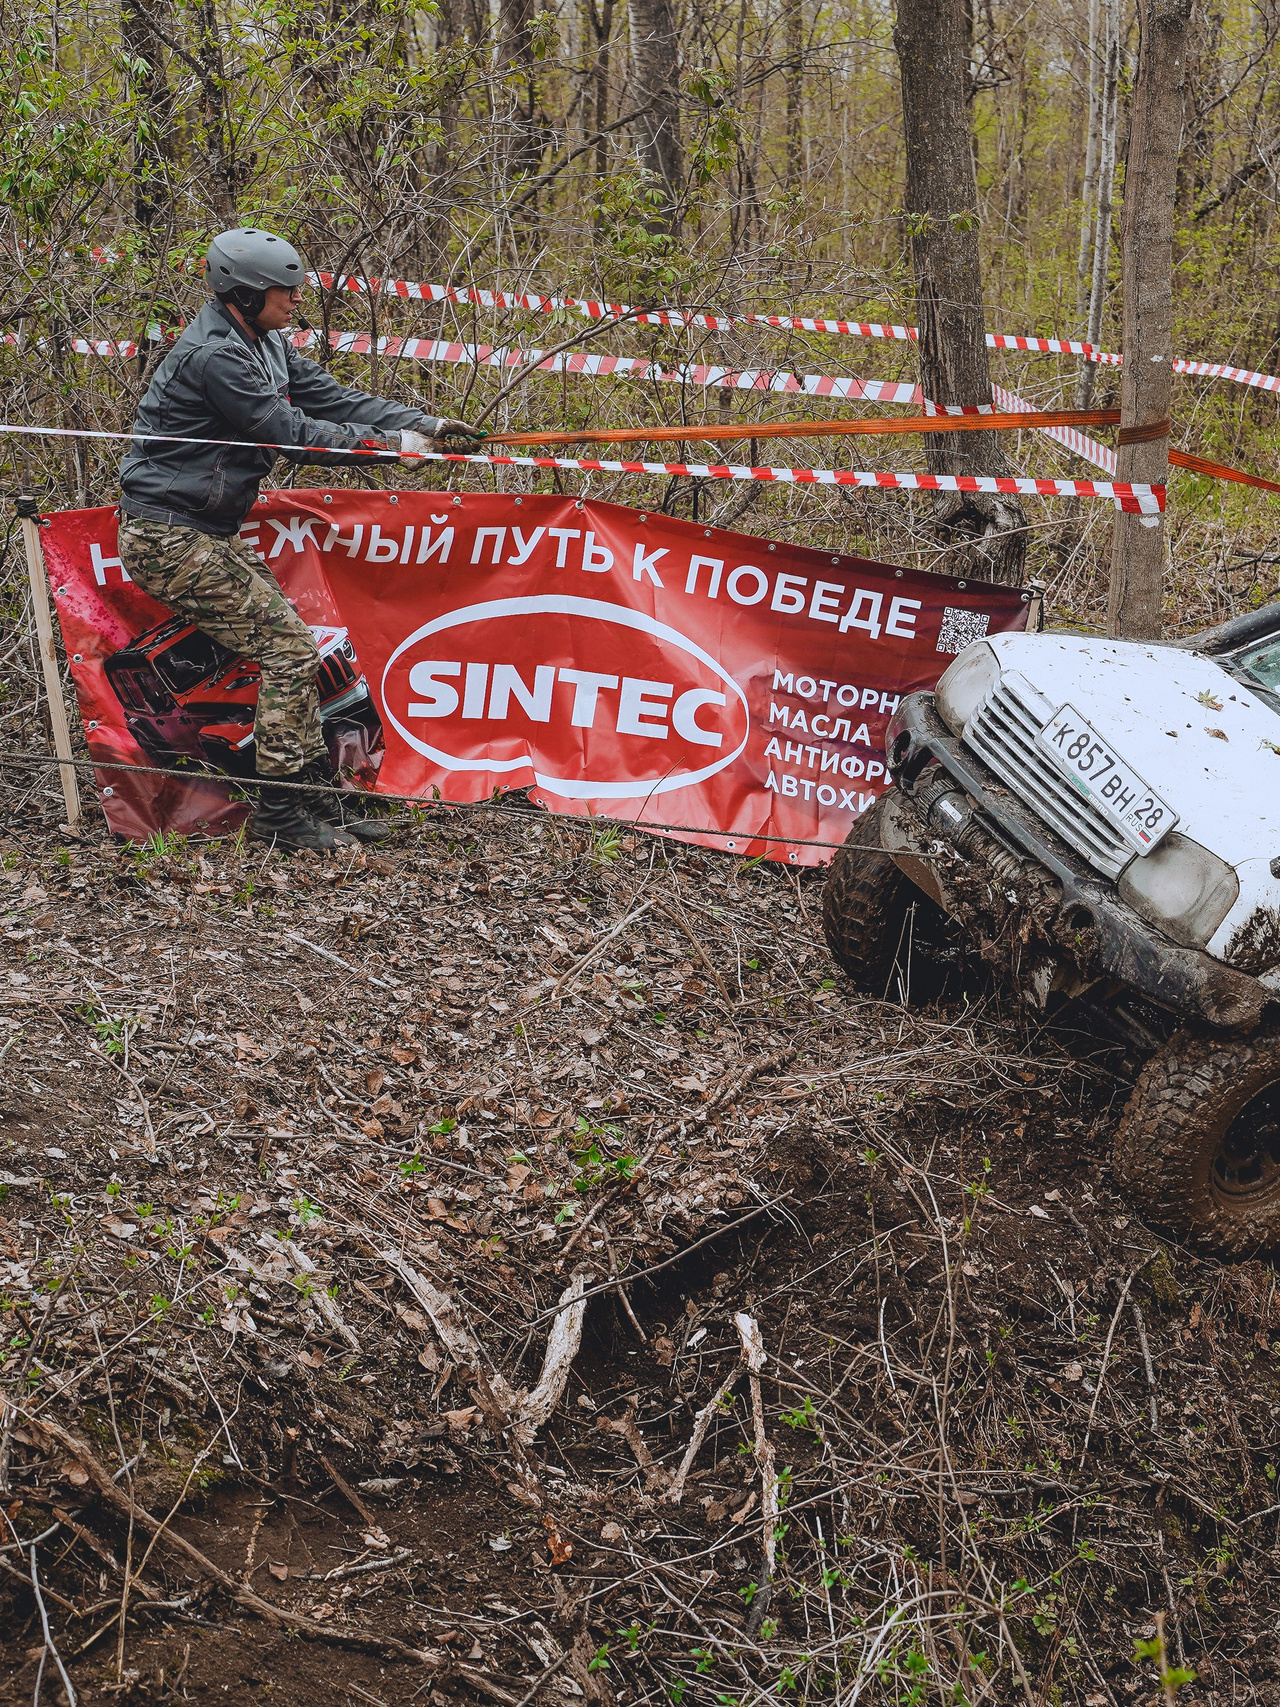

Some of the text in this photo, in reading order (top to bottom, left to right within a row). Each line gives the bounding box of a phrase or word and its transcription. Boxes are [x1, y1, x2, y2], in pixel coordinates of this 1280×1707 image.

[89, 513, 922, 640] НЕЖНЫЙ ПУТЬ К ПОБЕДЕ
[407, 660, 727, 747] SINTEC
[769, 702, 871, 746] МАСЛА
[1126, 814, 1143, 831] RUS
[1134, 798, 1164, 829] 28
